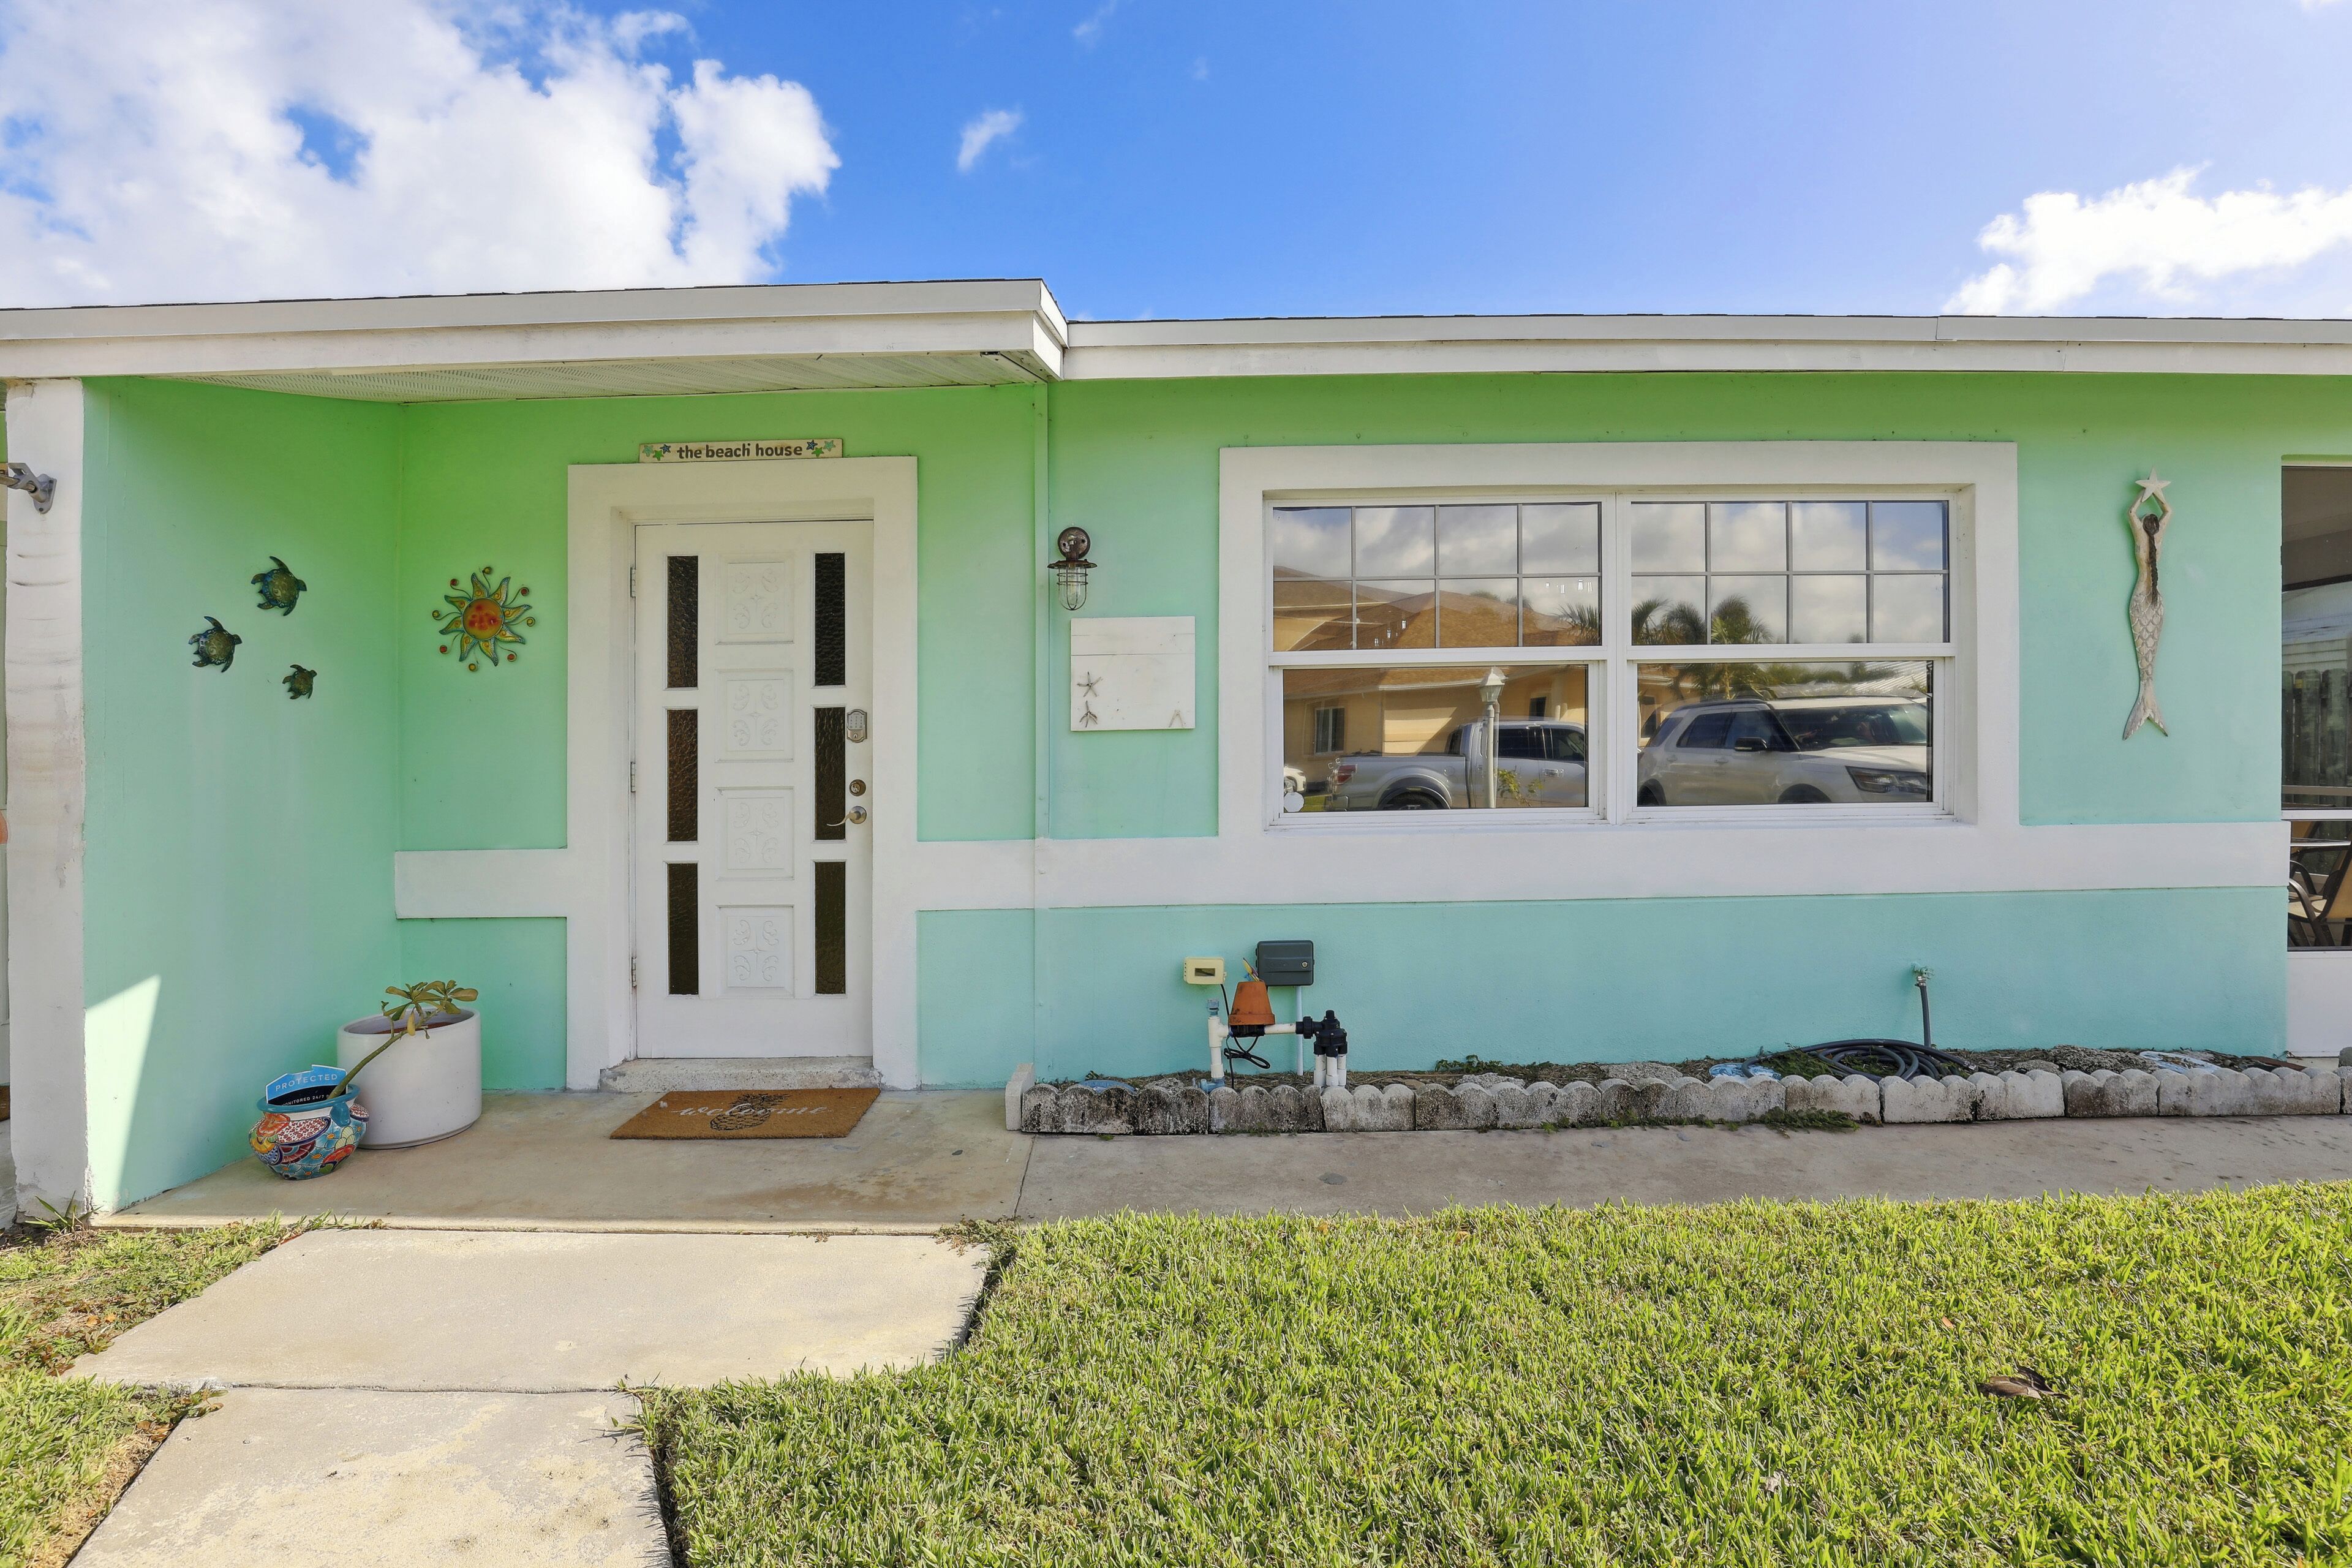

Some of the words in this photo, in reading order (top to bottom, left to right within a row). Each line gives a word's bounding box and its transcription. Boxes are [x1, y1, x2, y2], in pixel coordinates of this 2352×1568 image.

[677, 445, 703, 459] the
[706, 443, 751, 458] beach
[755, 443, 803, 456] house
[276, 1074, 337, 1091] PROTECTED
[671, 1102, 829, 1116] welcome
